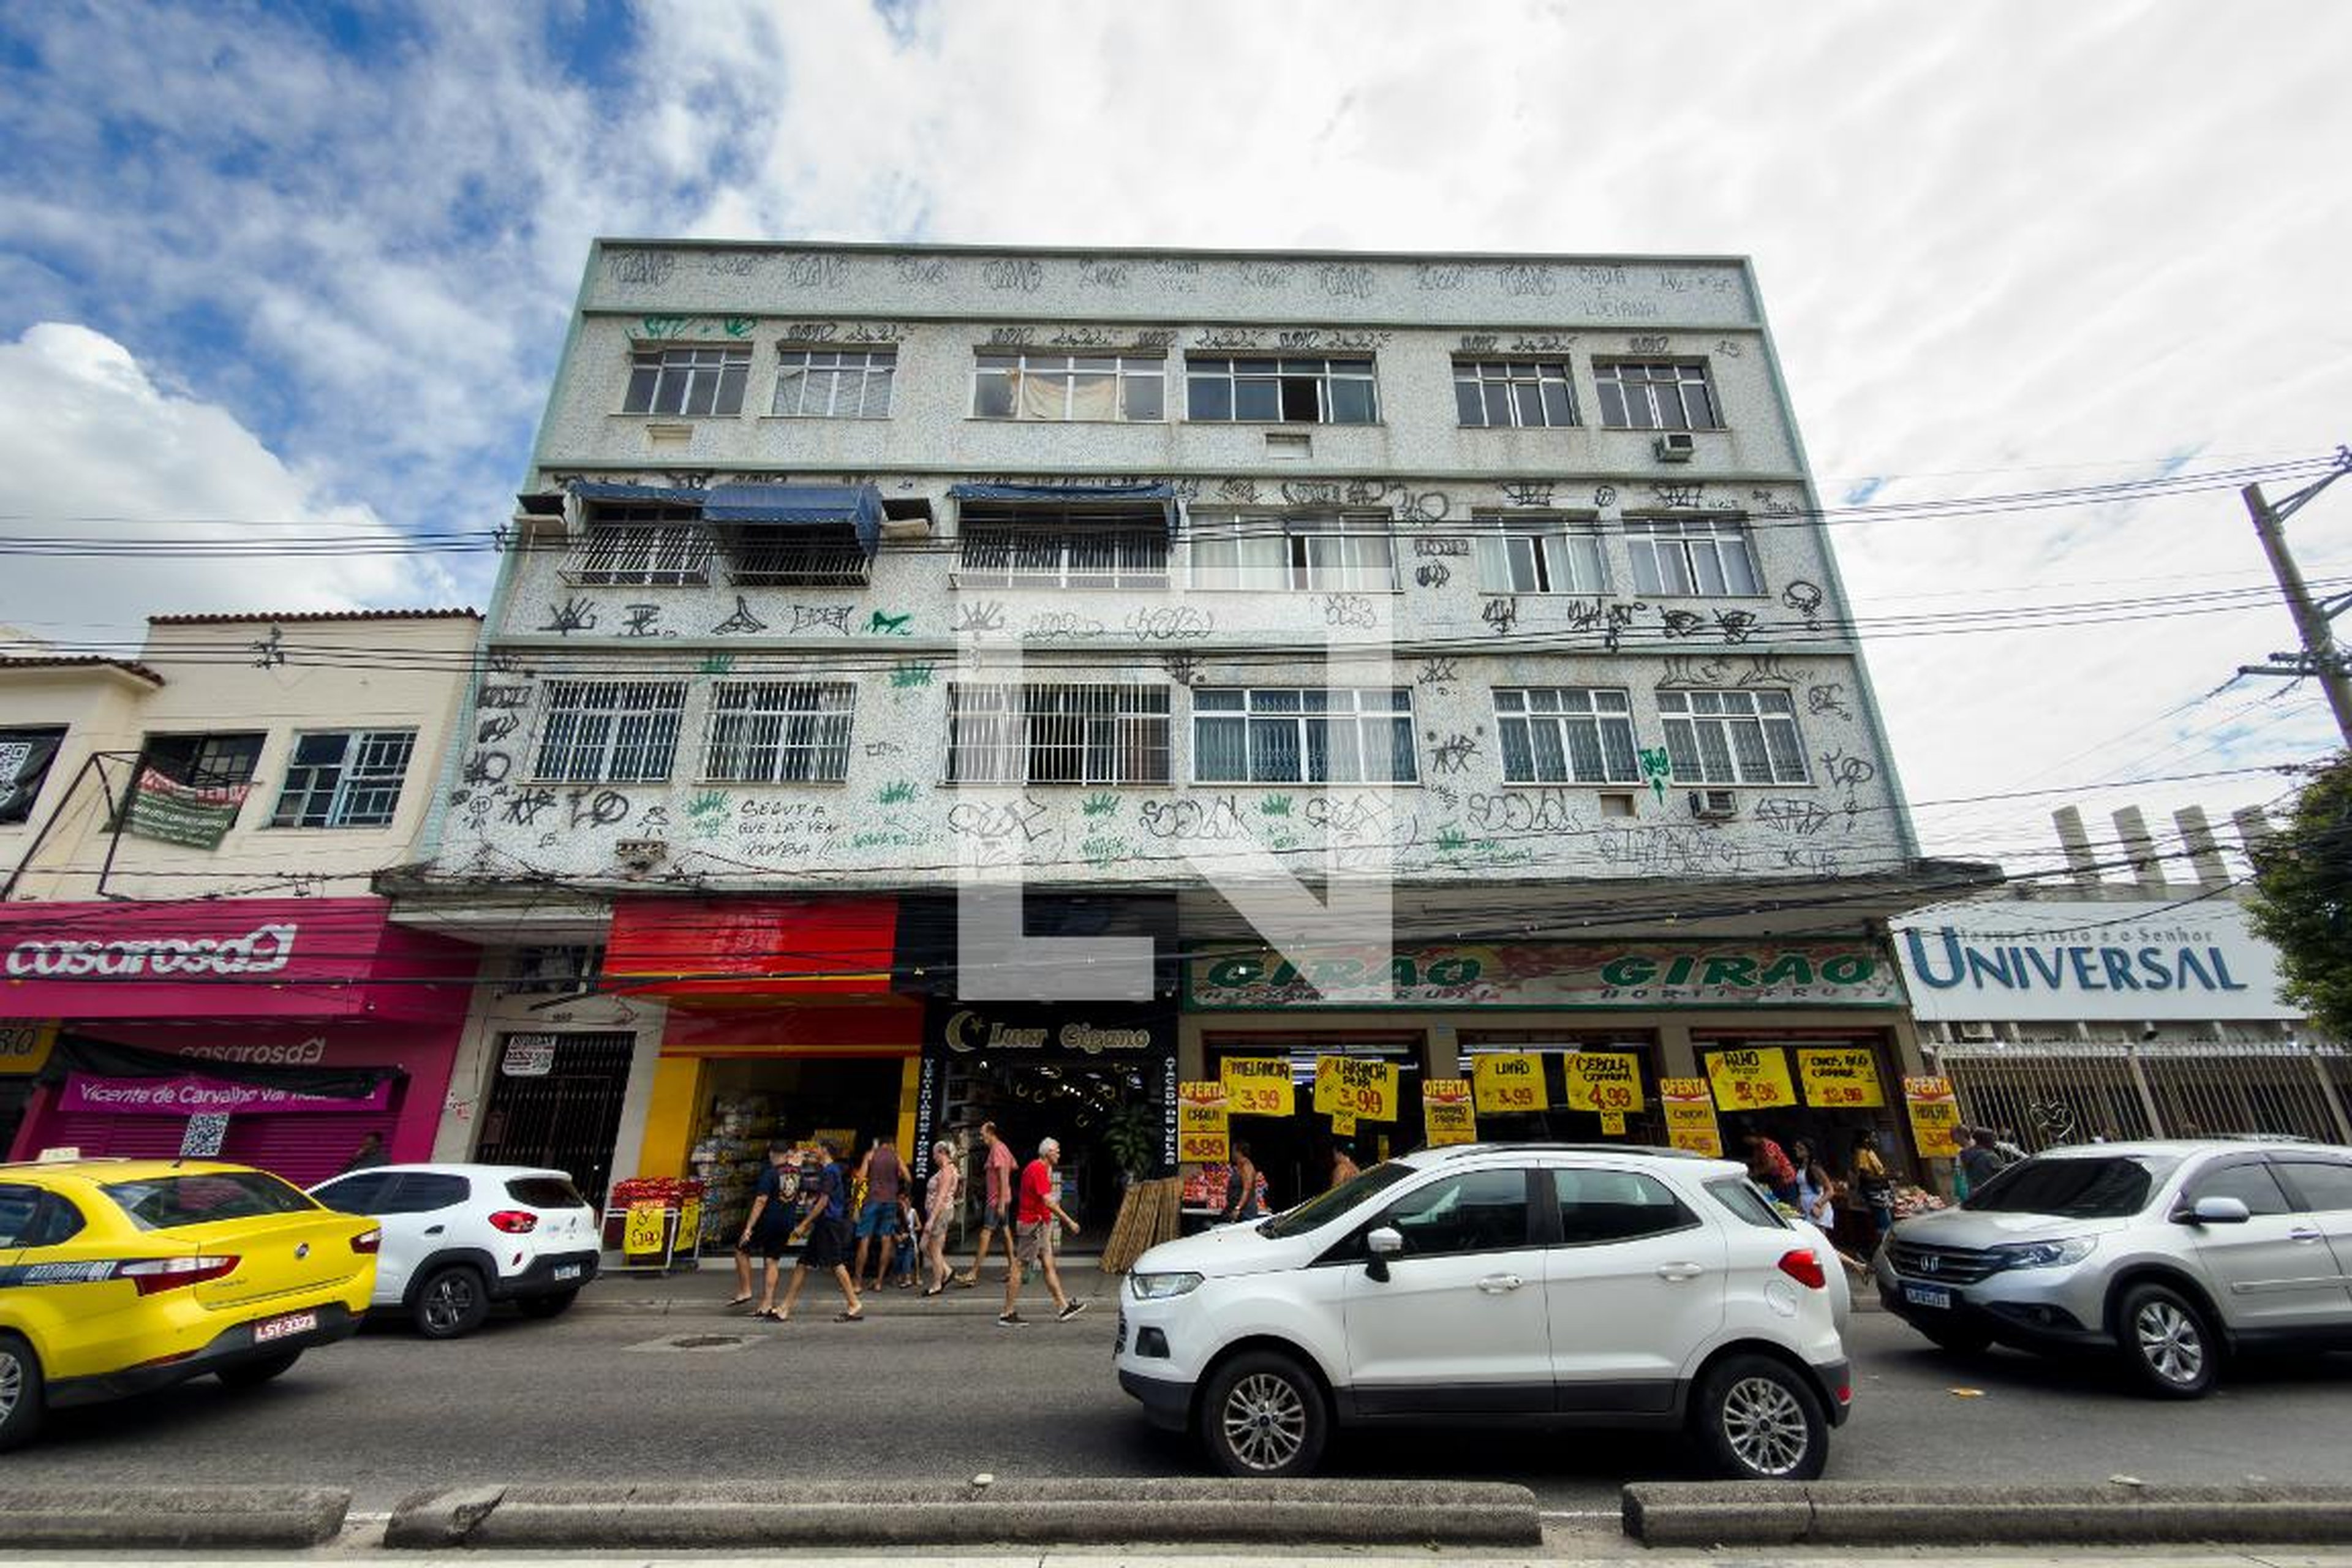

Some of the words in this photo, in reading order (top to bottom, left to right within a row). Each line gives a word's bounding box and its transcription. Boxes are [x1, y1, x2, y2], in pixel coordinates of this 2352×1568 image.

[6, 924, 298, 975] casarosa
[1905, 926, 2248, 990] UNIVERSAL
[1059, 1022, 1151, 1055] Cigano
[80, 1084, 149, 1103] Vicente
[153, 1085, 175, 1102] de
[179, 1087, 256, 1103] Carvalho
[1178, 1080, 1226, 1099] OFERTA
[1423, 1079, 1470, 1096] OFERTA
[1660, 1078, 1710, 1095] OFERTA
[1904, 1076, 1951, 1095] OFERTA
